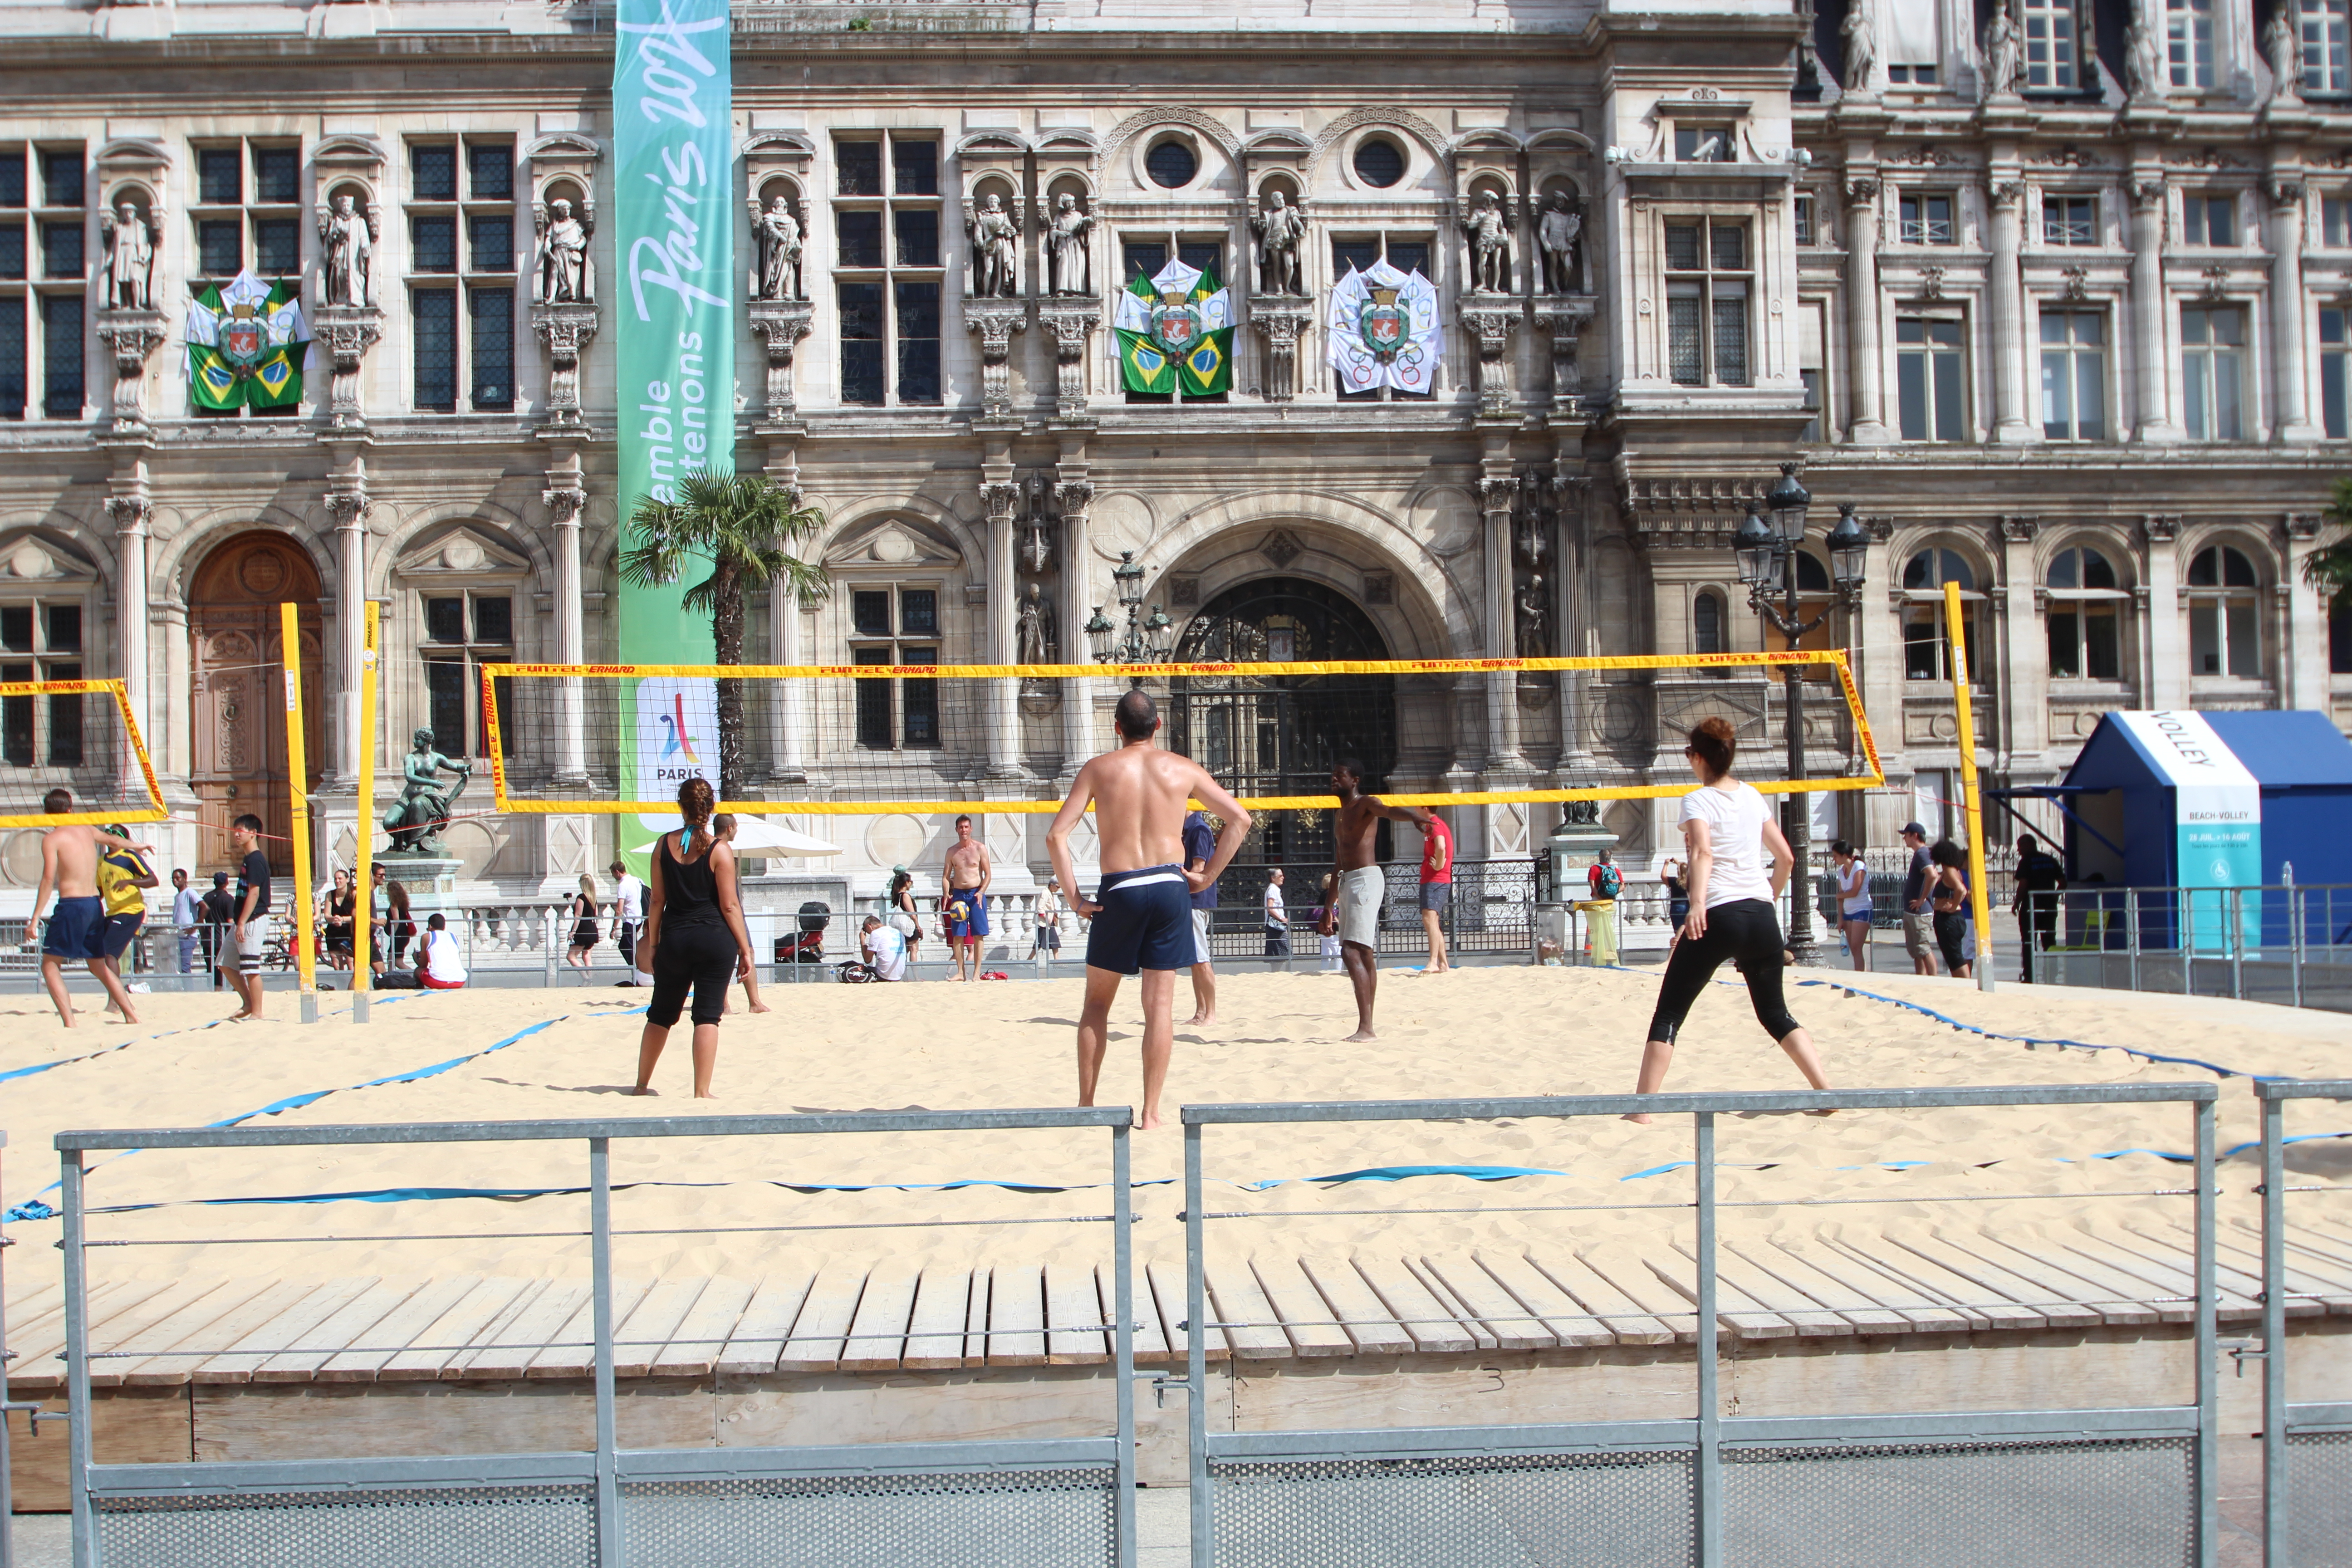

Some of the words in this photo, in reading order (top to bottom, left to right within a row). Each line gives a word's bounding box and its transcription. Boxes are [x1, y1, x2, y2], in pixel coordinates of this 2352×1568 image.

[630, 141, 730, 321] Paris
[44, 682, 88, 690] ERHARD
[484, 679, 495, 725] ERHARD
[1863, 731, 1882, 773] ERHARD
[2151, 710, 2215, 767] VOLLEY
[142, 762, 163, 805] ERHARD
[490, 732, 503, 798] FUNTEC
[657, 768, 702, 779] PARIS
[2189, 811, 2249, 820] BEACH-VOLLEY
